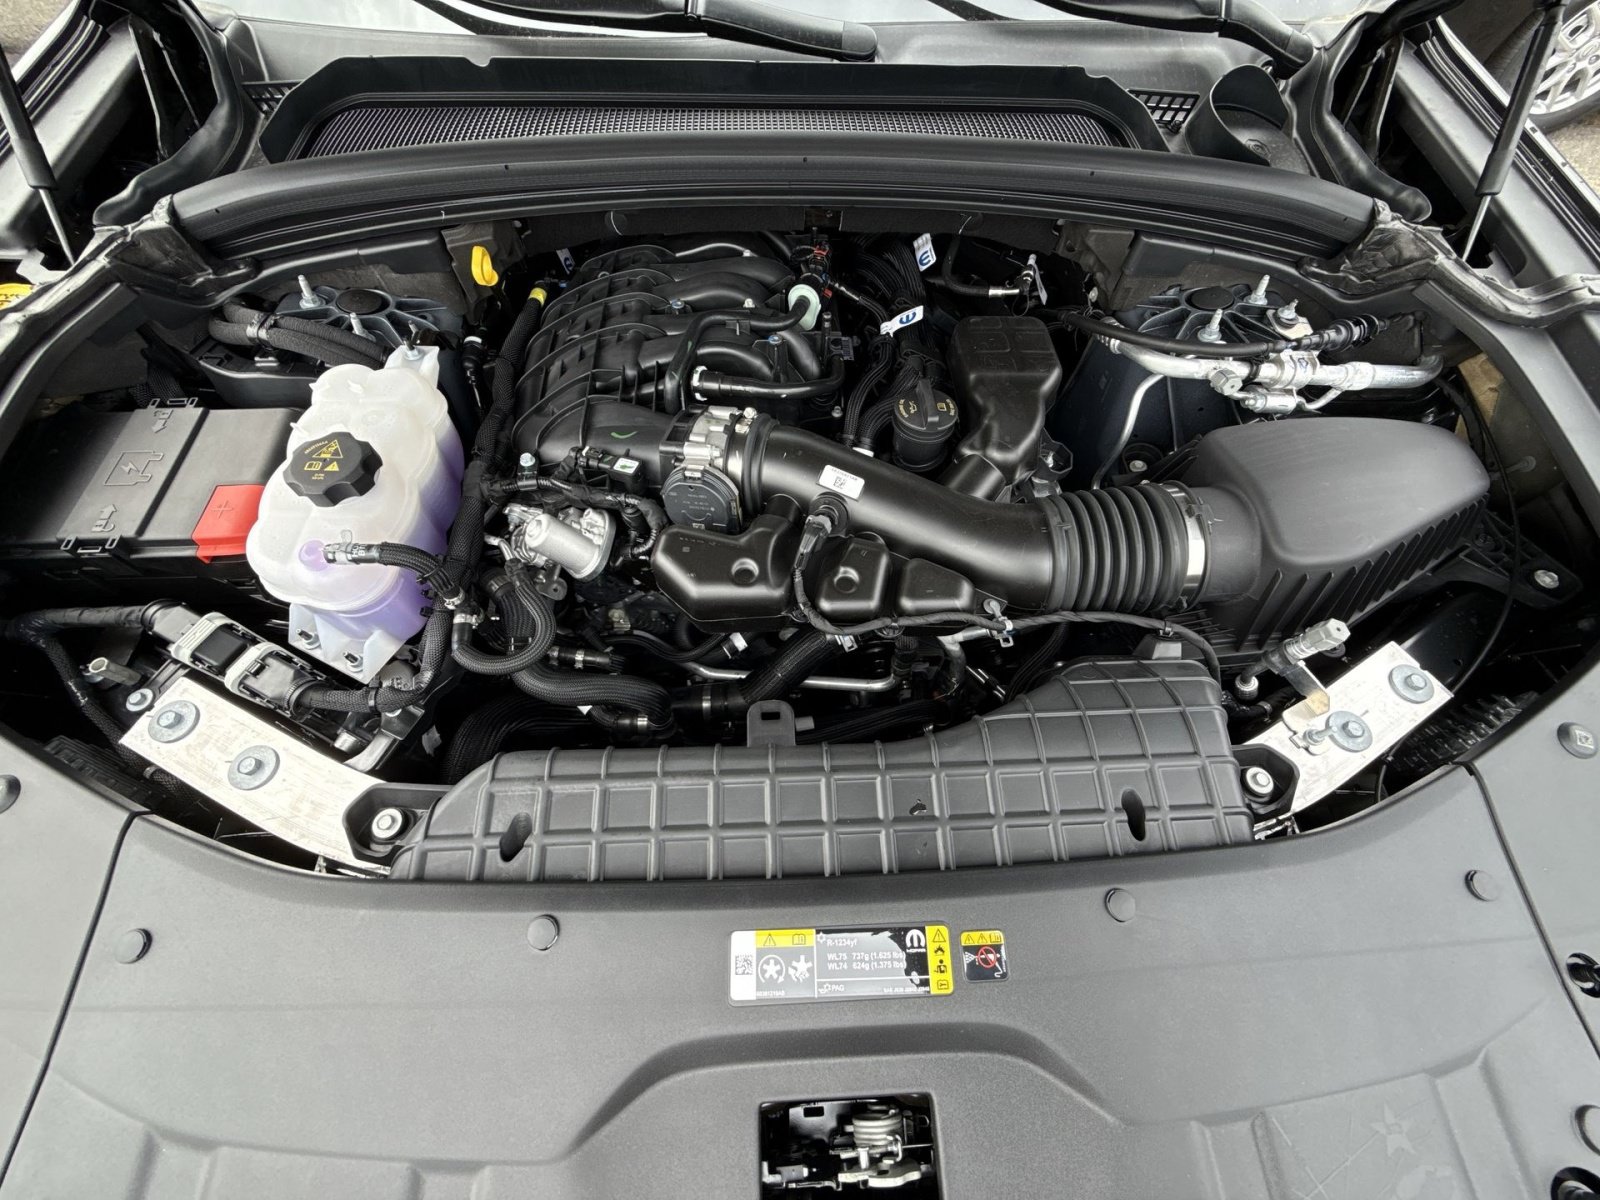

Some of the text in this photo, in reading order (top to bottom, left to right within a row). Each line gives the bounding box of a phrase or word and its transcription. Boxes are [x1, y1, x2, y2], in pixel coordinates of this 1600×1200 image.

[826, 939, 858, 948] R-1234yf
[826, 951, 906, 961] WL75 737g (1.625 lbs)
[827, 962, 848, 970] WL74
[871, 961, 892, 970] (1.375
[893, 960, 907, 969] lbs)
[831, 984, 845, 992] PAG
